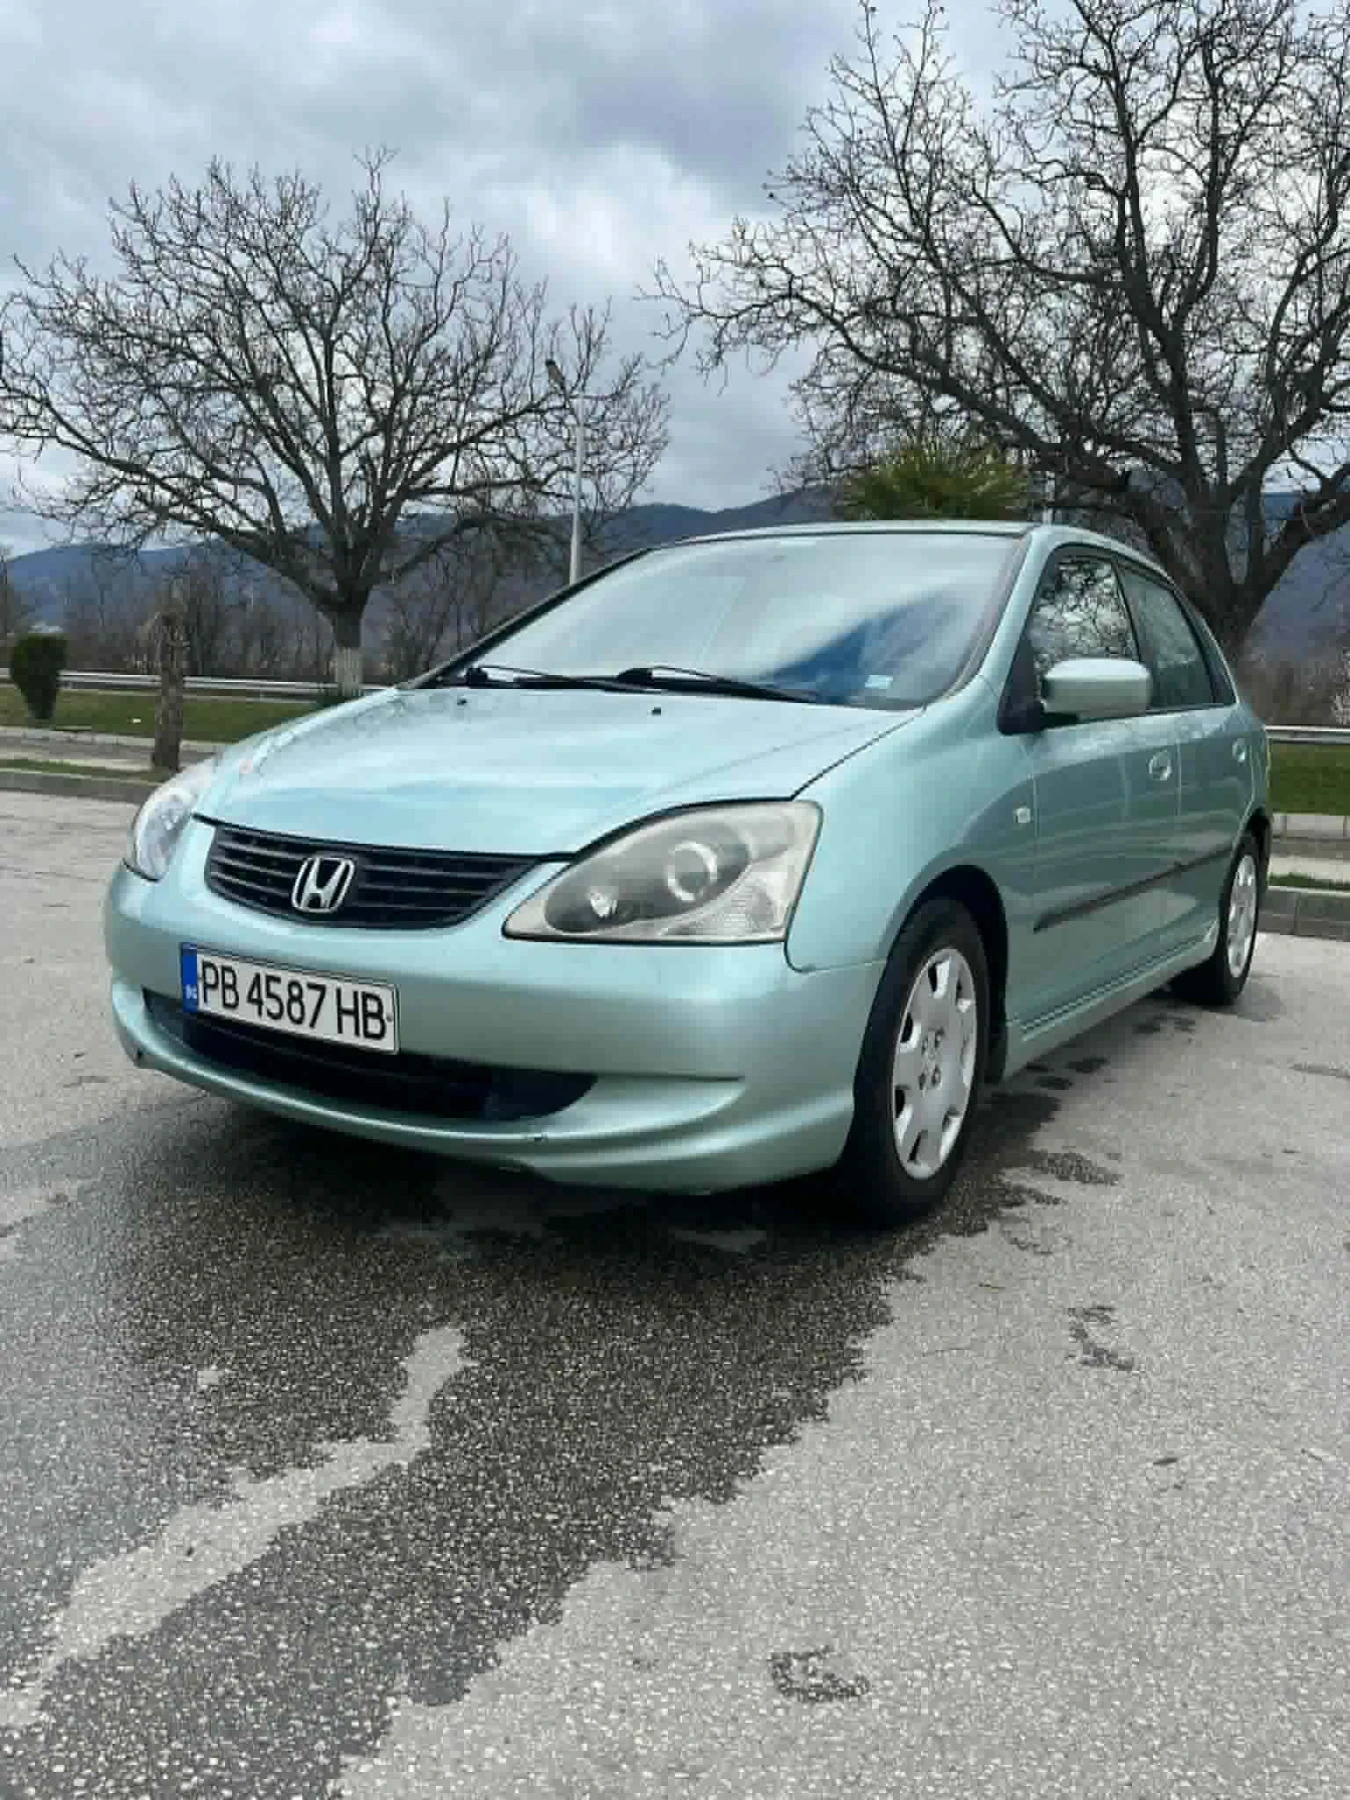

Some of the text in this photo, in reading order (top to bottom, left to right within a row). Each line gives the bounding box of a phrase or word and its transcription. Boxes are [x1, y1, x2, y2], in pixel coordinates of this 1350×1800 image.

[202, 960, 386, 1041] PB 4587 HB
